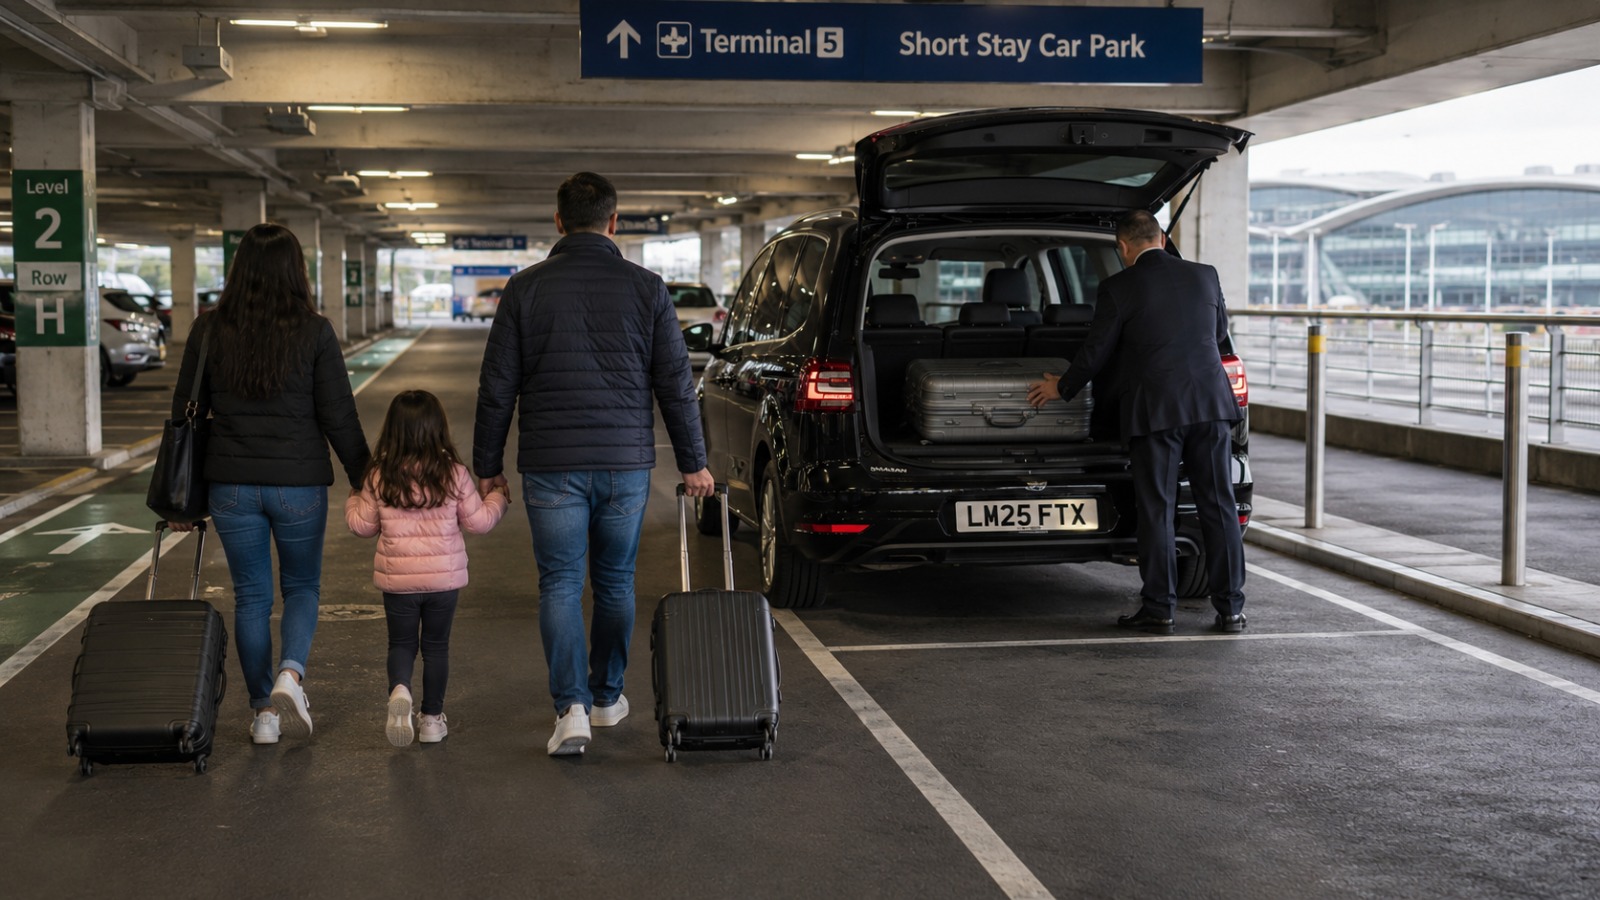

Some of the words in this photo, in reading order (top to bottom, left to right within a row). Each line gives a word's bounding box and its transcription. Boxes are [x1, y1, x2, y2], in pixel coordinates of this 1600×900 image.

[700, 28, 811, 55] Terminal
[823, 31, 838, 54] 5
[899, 30, 969, 57] Short
[976, 32, 1032, 63] Stay
[1039, 33, 1082, 58] Car
[1090, 33, 1146, 58] Park
[26, 178, 69, 195] Level
[34, 207, 62, 249] 2
[31, 269, 68, 286] Row
[35, 297, 65, 335] H
[966, 502, 1031, 528] LM25
[1038, 501, 1087, 527] FTX
